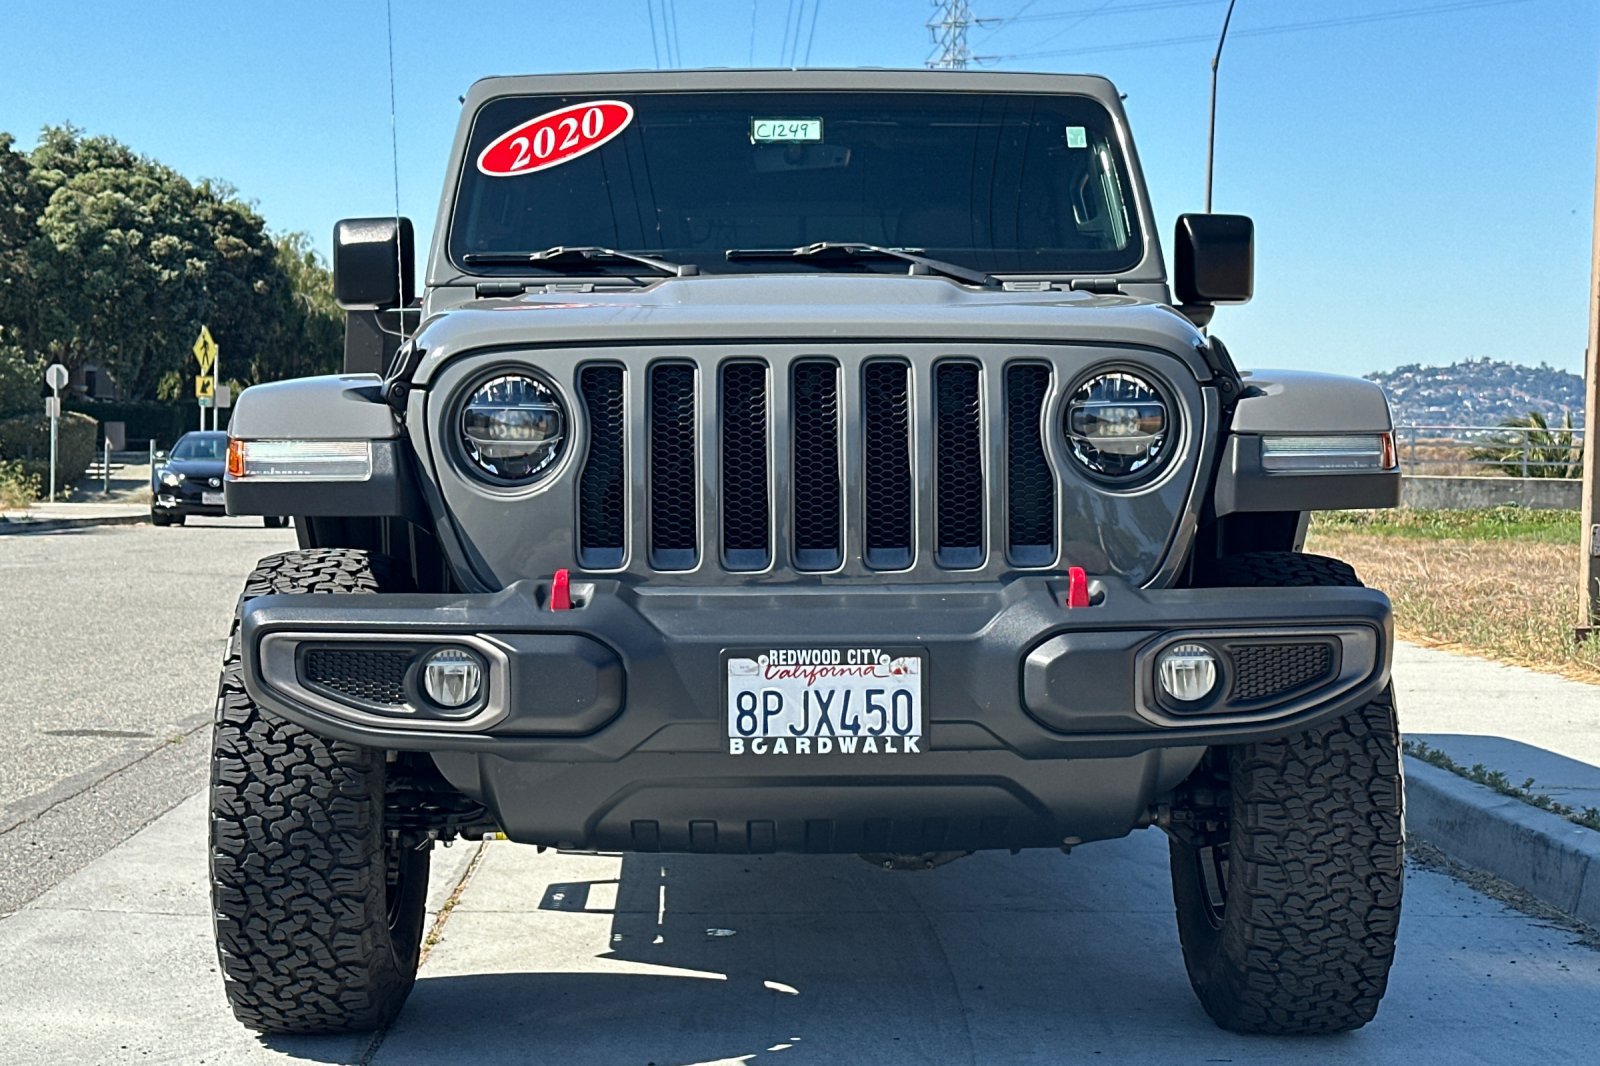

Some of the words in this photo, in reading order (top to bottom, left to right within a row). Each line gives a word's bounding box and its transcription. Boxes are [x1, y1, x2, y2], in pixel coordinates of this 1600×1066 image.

[509, 107, 604, 171] 2020
[756, 123, 809, 138] C1249
[769, 649, 841, 665] REDWOOD
[847, 649, 881, 665] CITY
[764, 664, 890, 686] California
[736, 688, 913, 736] 8PJX450
[729, 736, 921, 755] BOARDWALK
